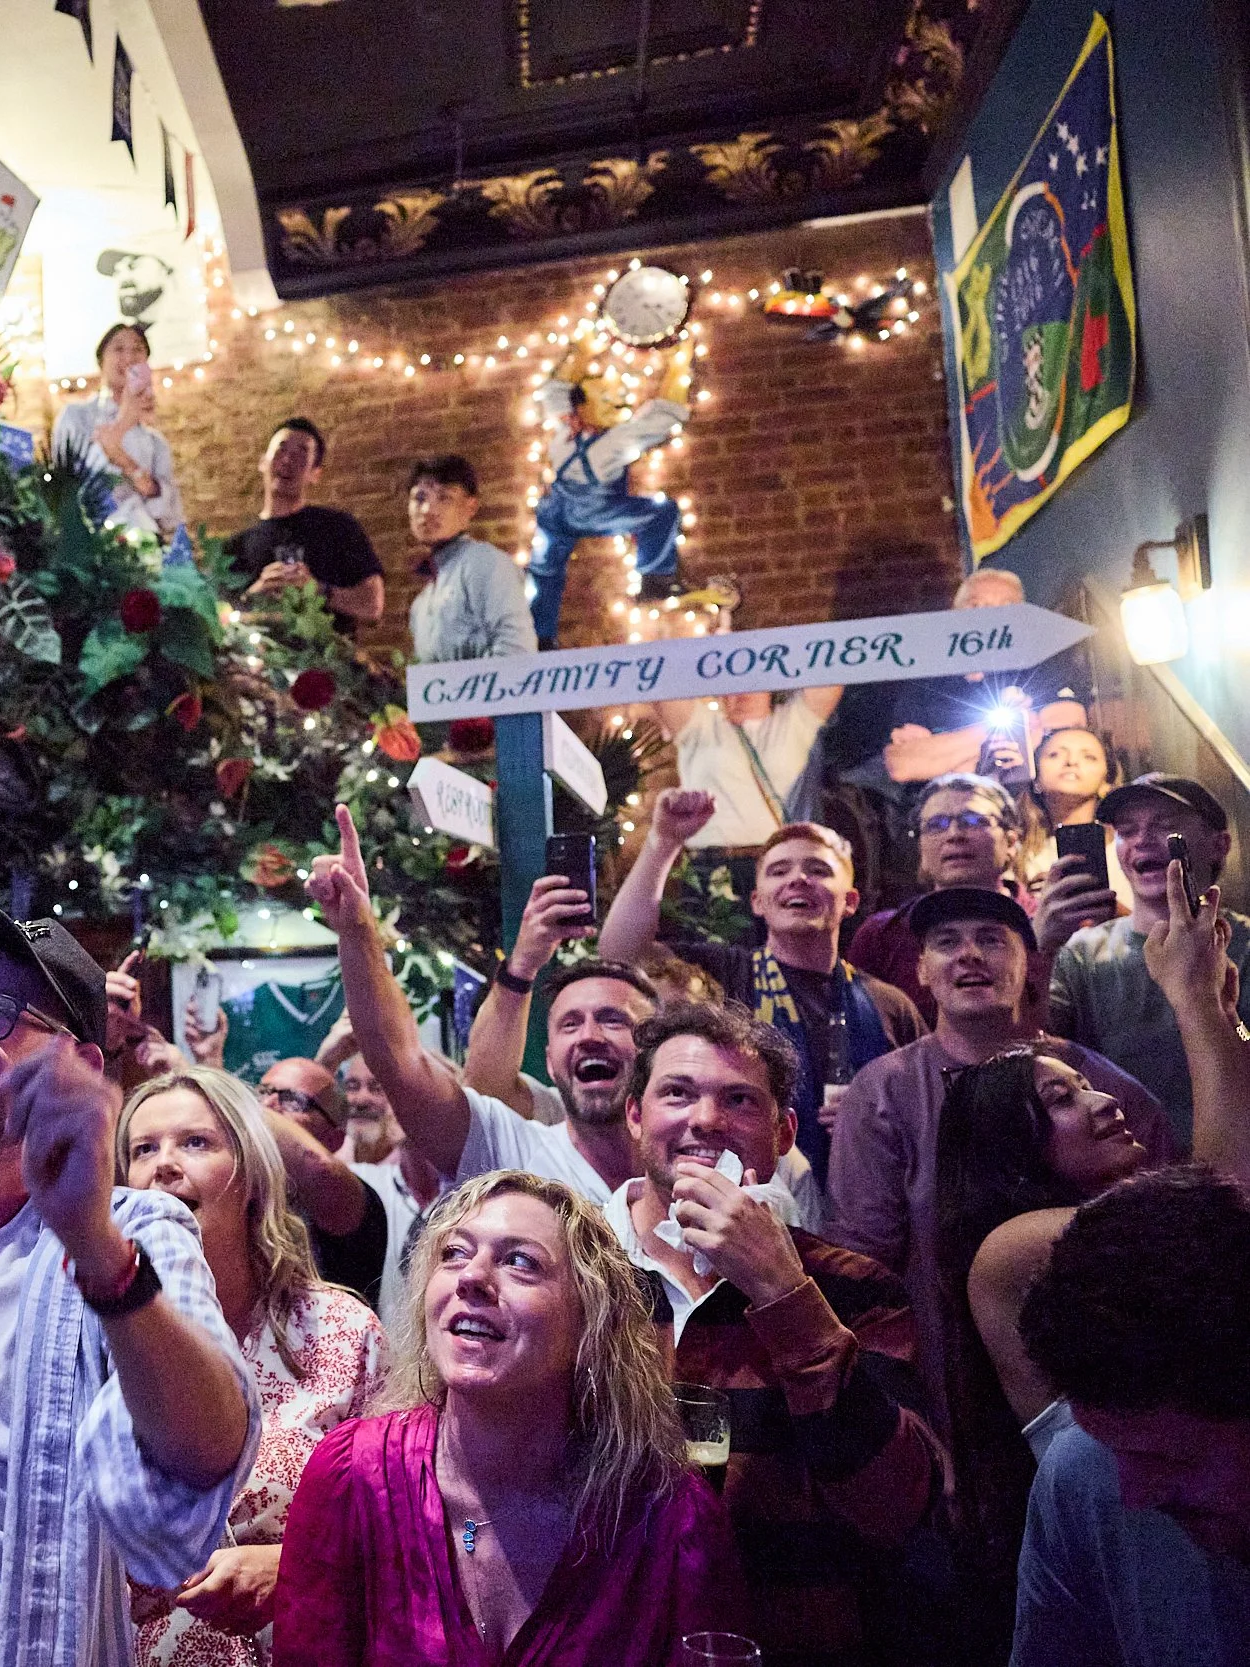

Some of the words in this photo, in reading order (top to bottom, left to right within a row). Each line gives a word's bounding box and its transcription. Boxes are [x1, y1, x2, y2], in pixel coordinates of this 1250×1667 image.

[422, 656, 665, 704] CALAMITY
[697, 632, 915, 679] CORNER
[946, 625, 1014, 657] 16th
